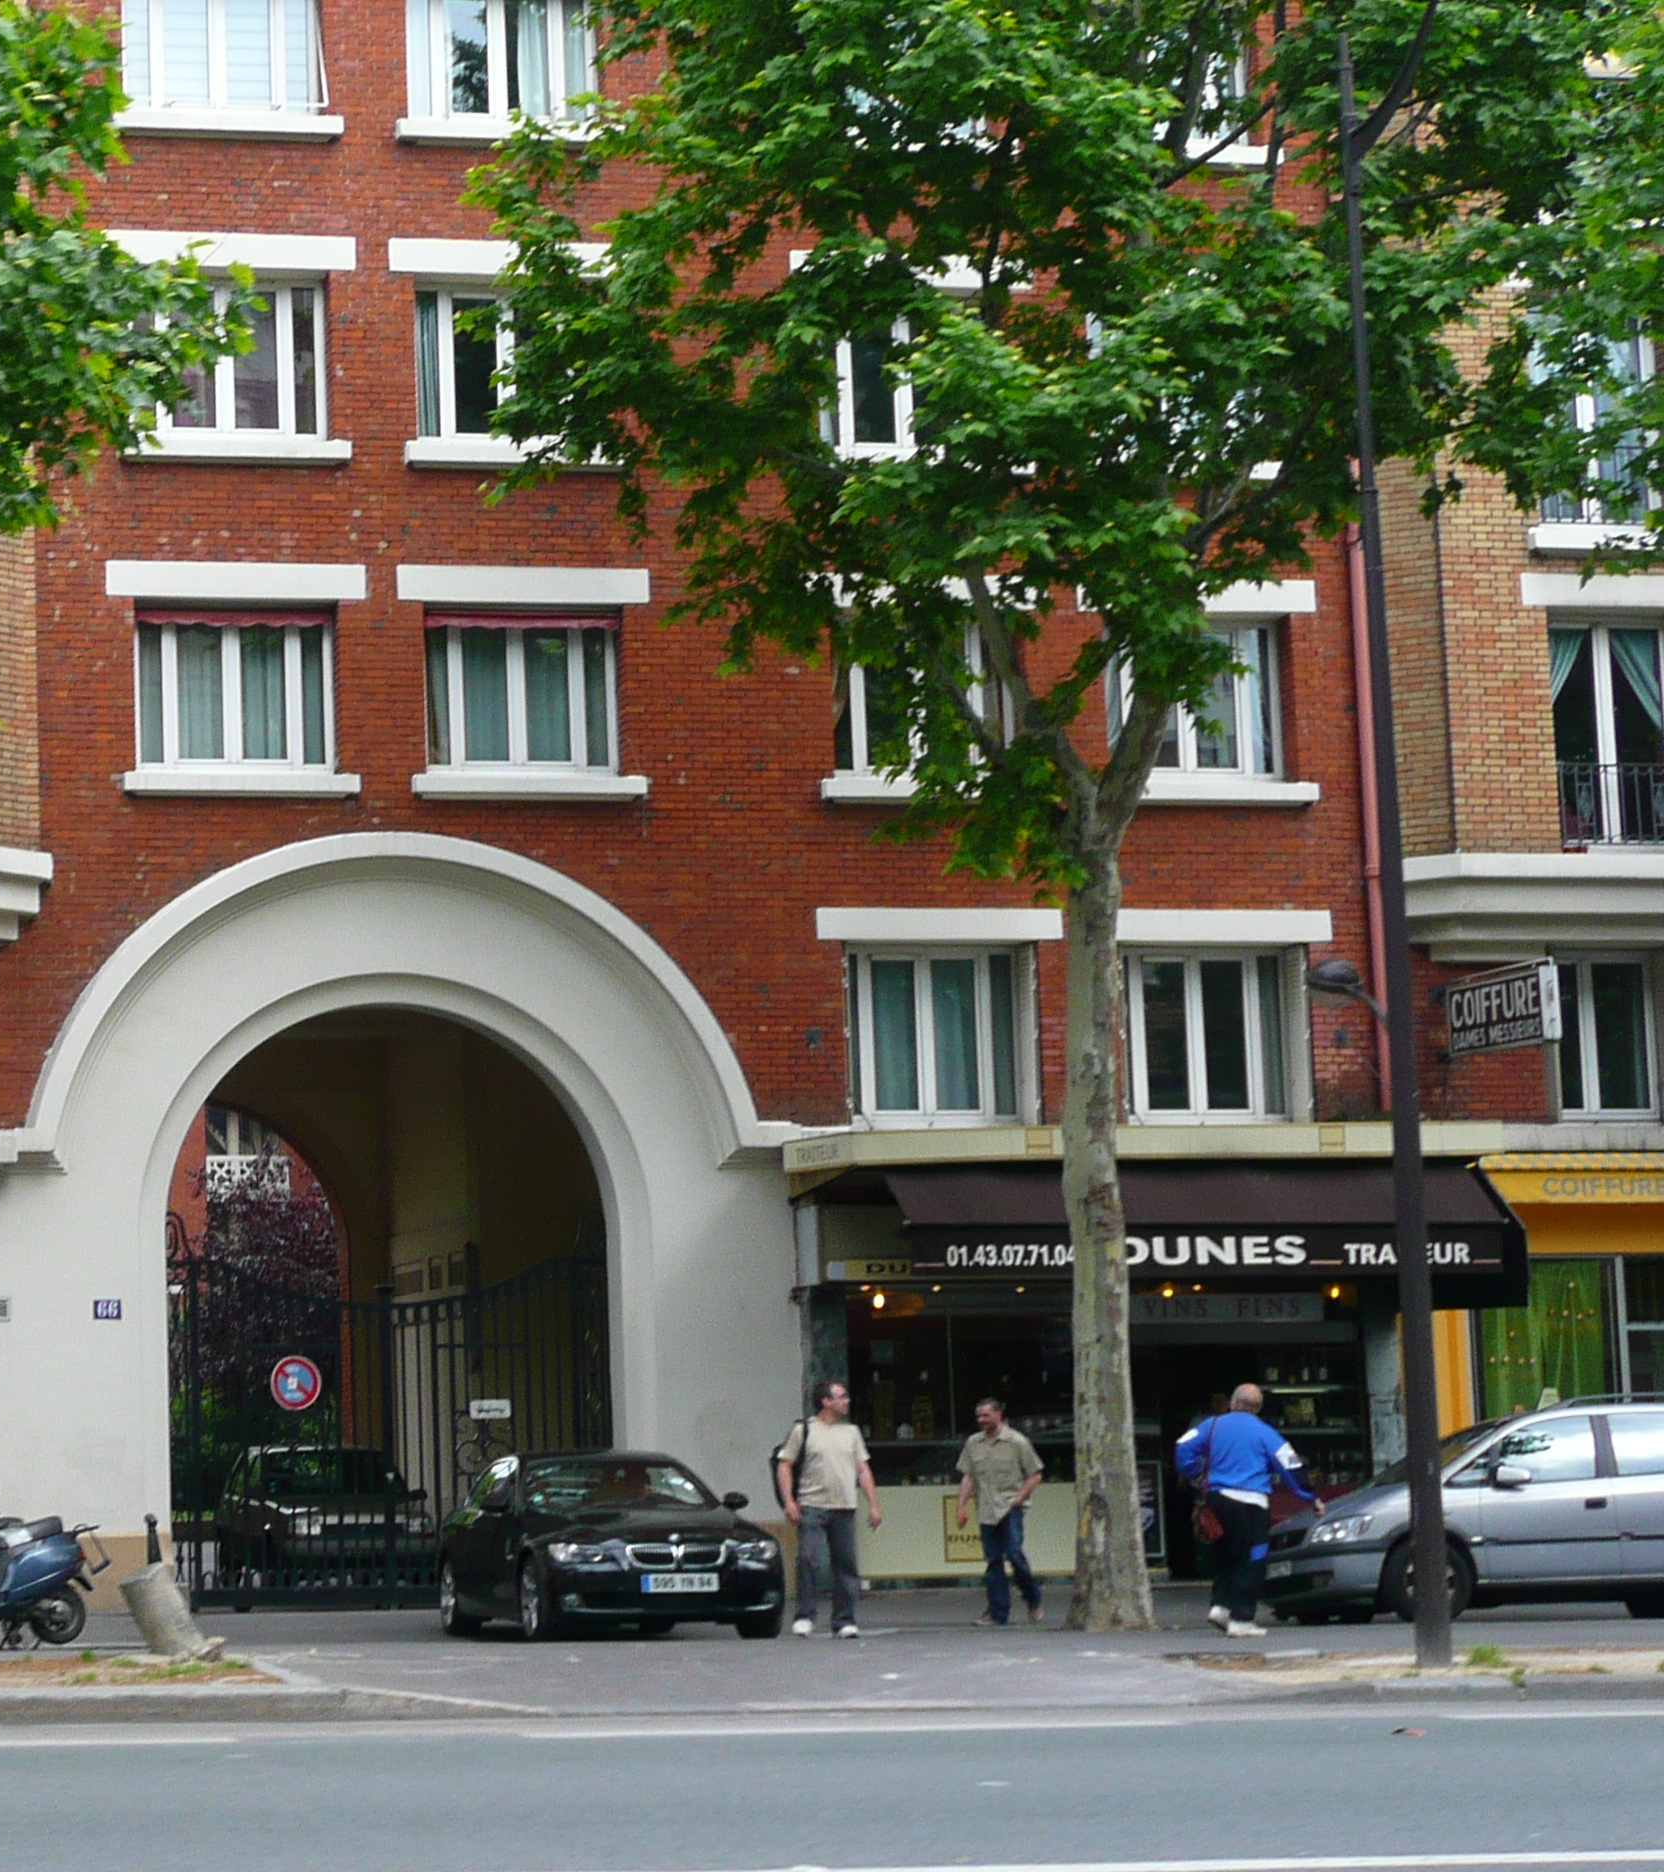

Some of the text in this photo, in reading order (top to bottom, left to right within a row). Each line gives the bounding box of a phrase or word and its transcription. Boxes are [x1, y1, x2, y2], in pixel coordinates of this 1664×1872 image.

[1451, 977, 1540, 1029] COIFFURE
[1452, 1017, 1542, 1051] DAMES MESSIEURS
[1343, 1243, 1471, 1265] TRAEUR
[97, 1301, 118, 1318] 66
[1142, 1298, 1301, 1317] VINS FINS
